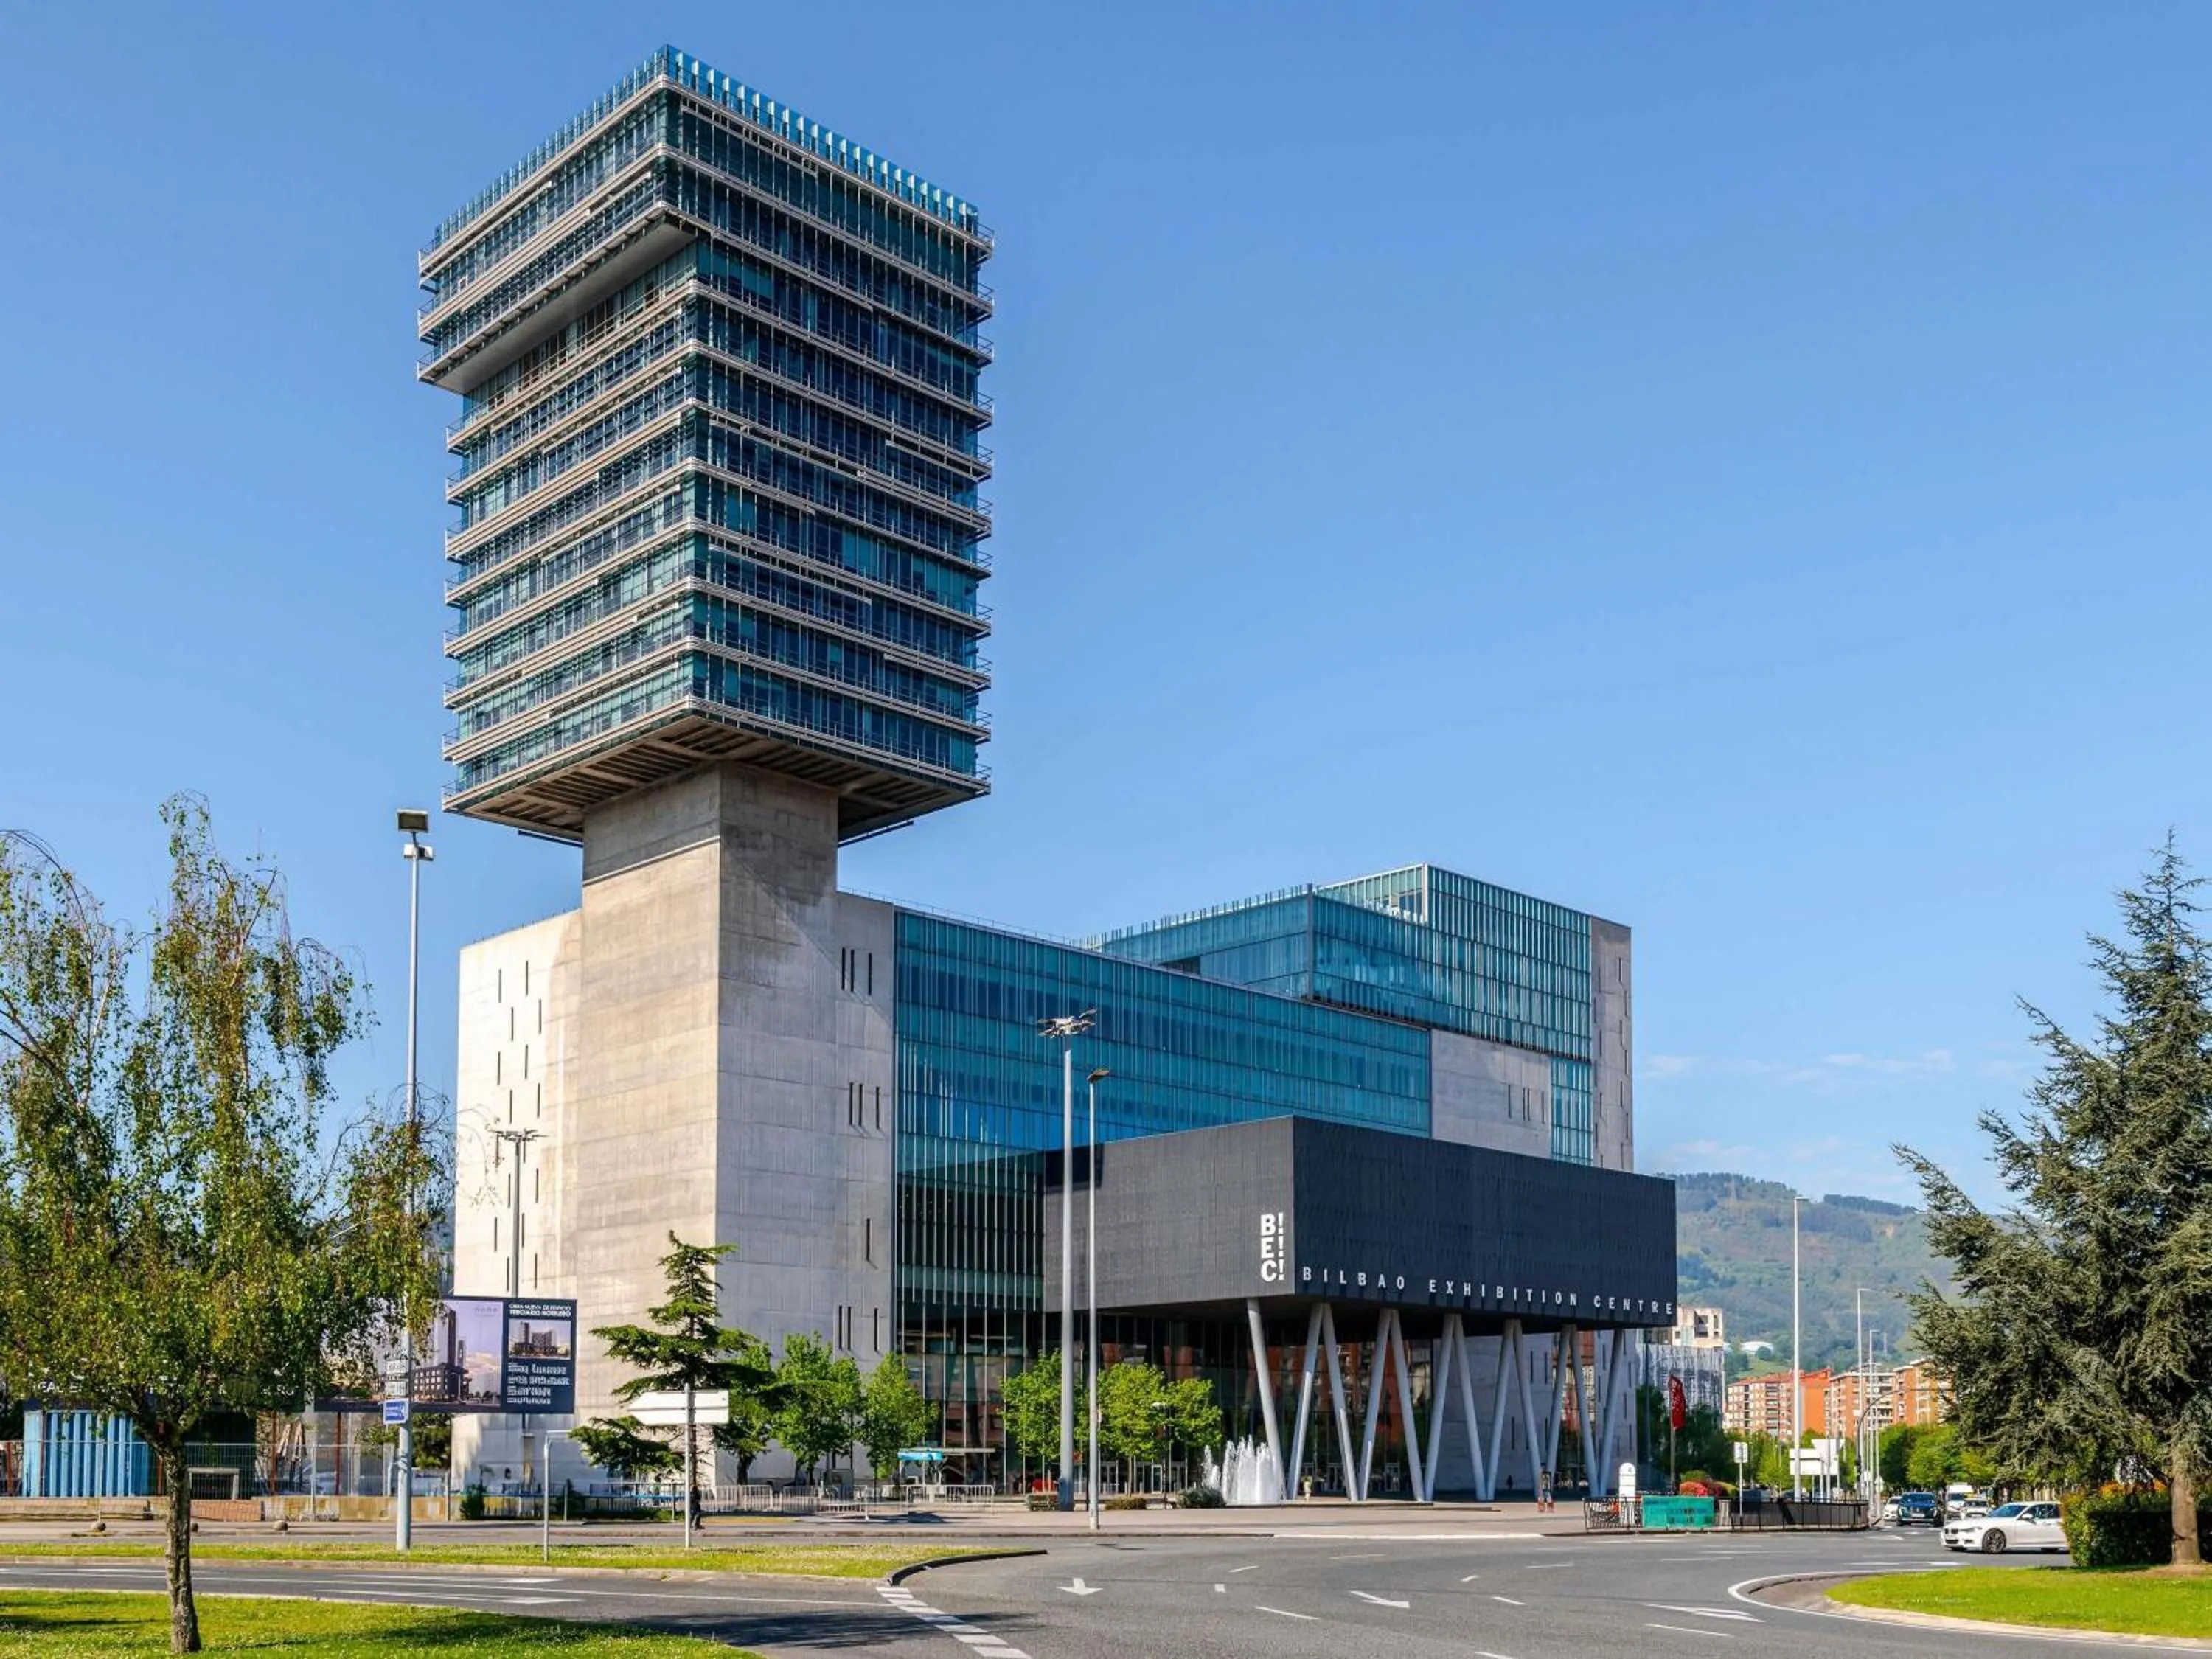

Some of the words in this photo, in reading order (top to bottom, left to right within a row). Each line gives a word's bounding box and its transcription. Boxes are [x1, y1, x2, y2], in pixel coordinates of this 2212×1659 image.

[1303, 1267, 1405, 1290] BILBAO
[1429, 1280, 1577, 1306] EXHIBITION
[1593, 1295, 1673, 1315] CENTRE
